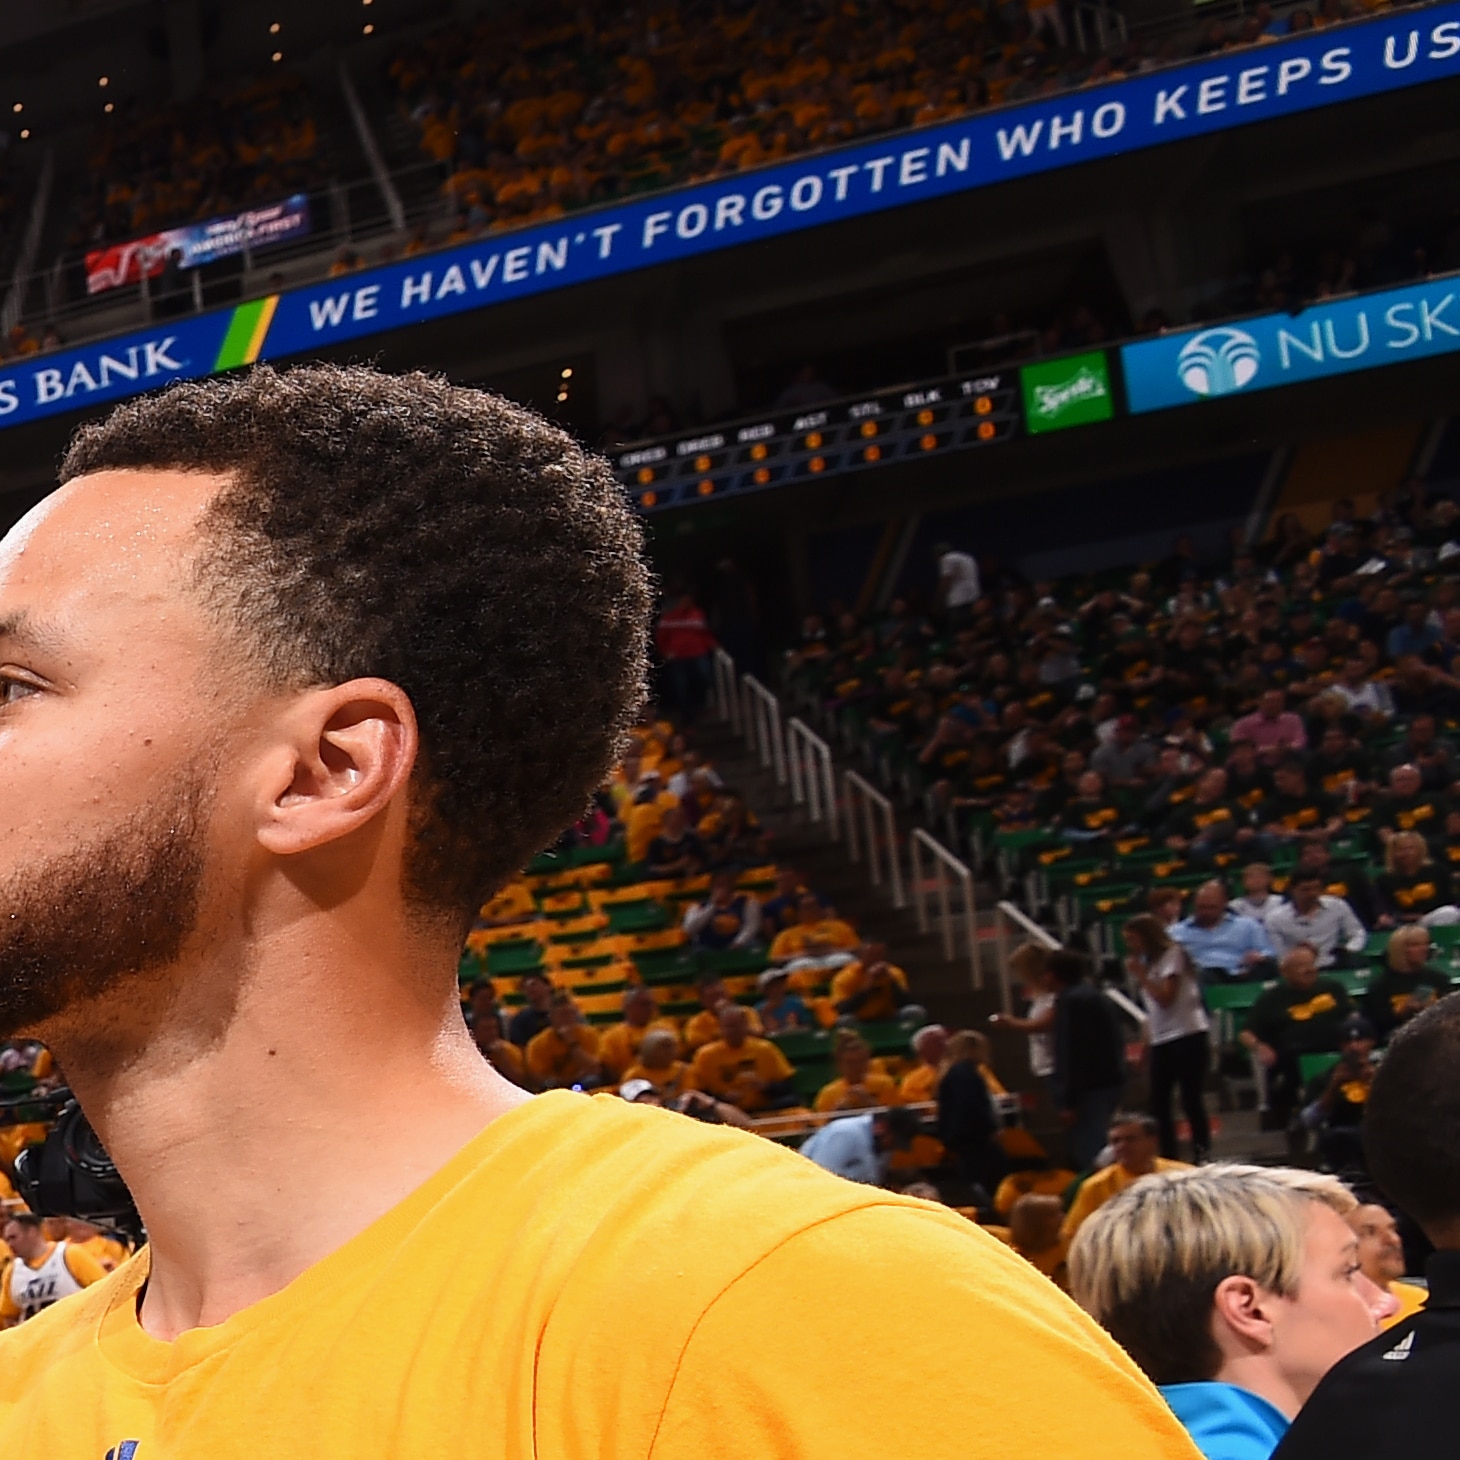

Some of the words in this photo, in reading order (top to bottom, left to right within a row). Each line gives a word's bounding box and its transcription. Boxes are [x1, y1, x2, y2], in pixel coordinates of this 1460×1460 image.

[309, 285, 380, 332] WE
[401, 223, 623, 308] HAVEN'T
[642, 138, 970, 249] FORGOTTEN
[997, 101, 1127, 161] WHO
[1154, 47, 1354, 126] KEEPS
[34, 336, 186, 407] BANK
[1278, 312, 1371, 370] NU
